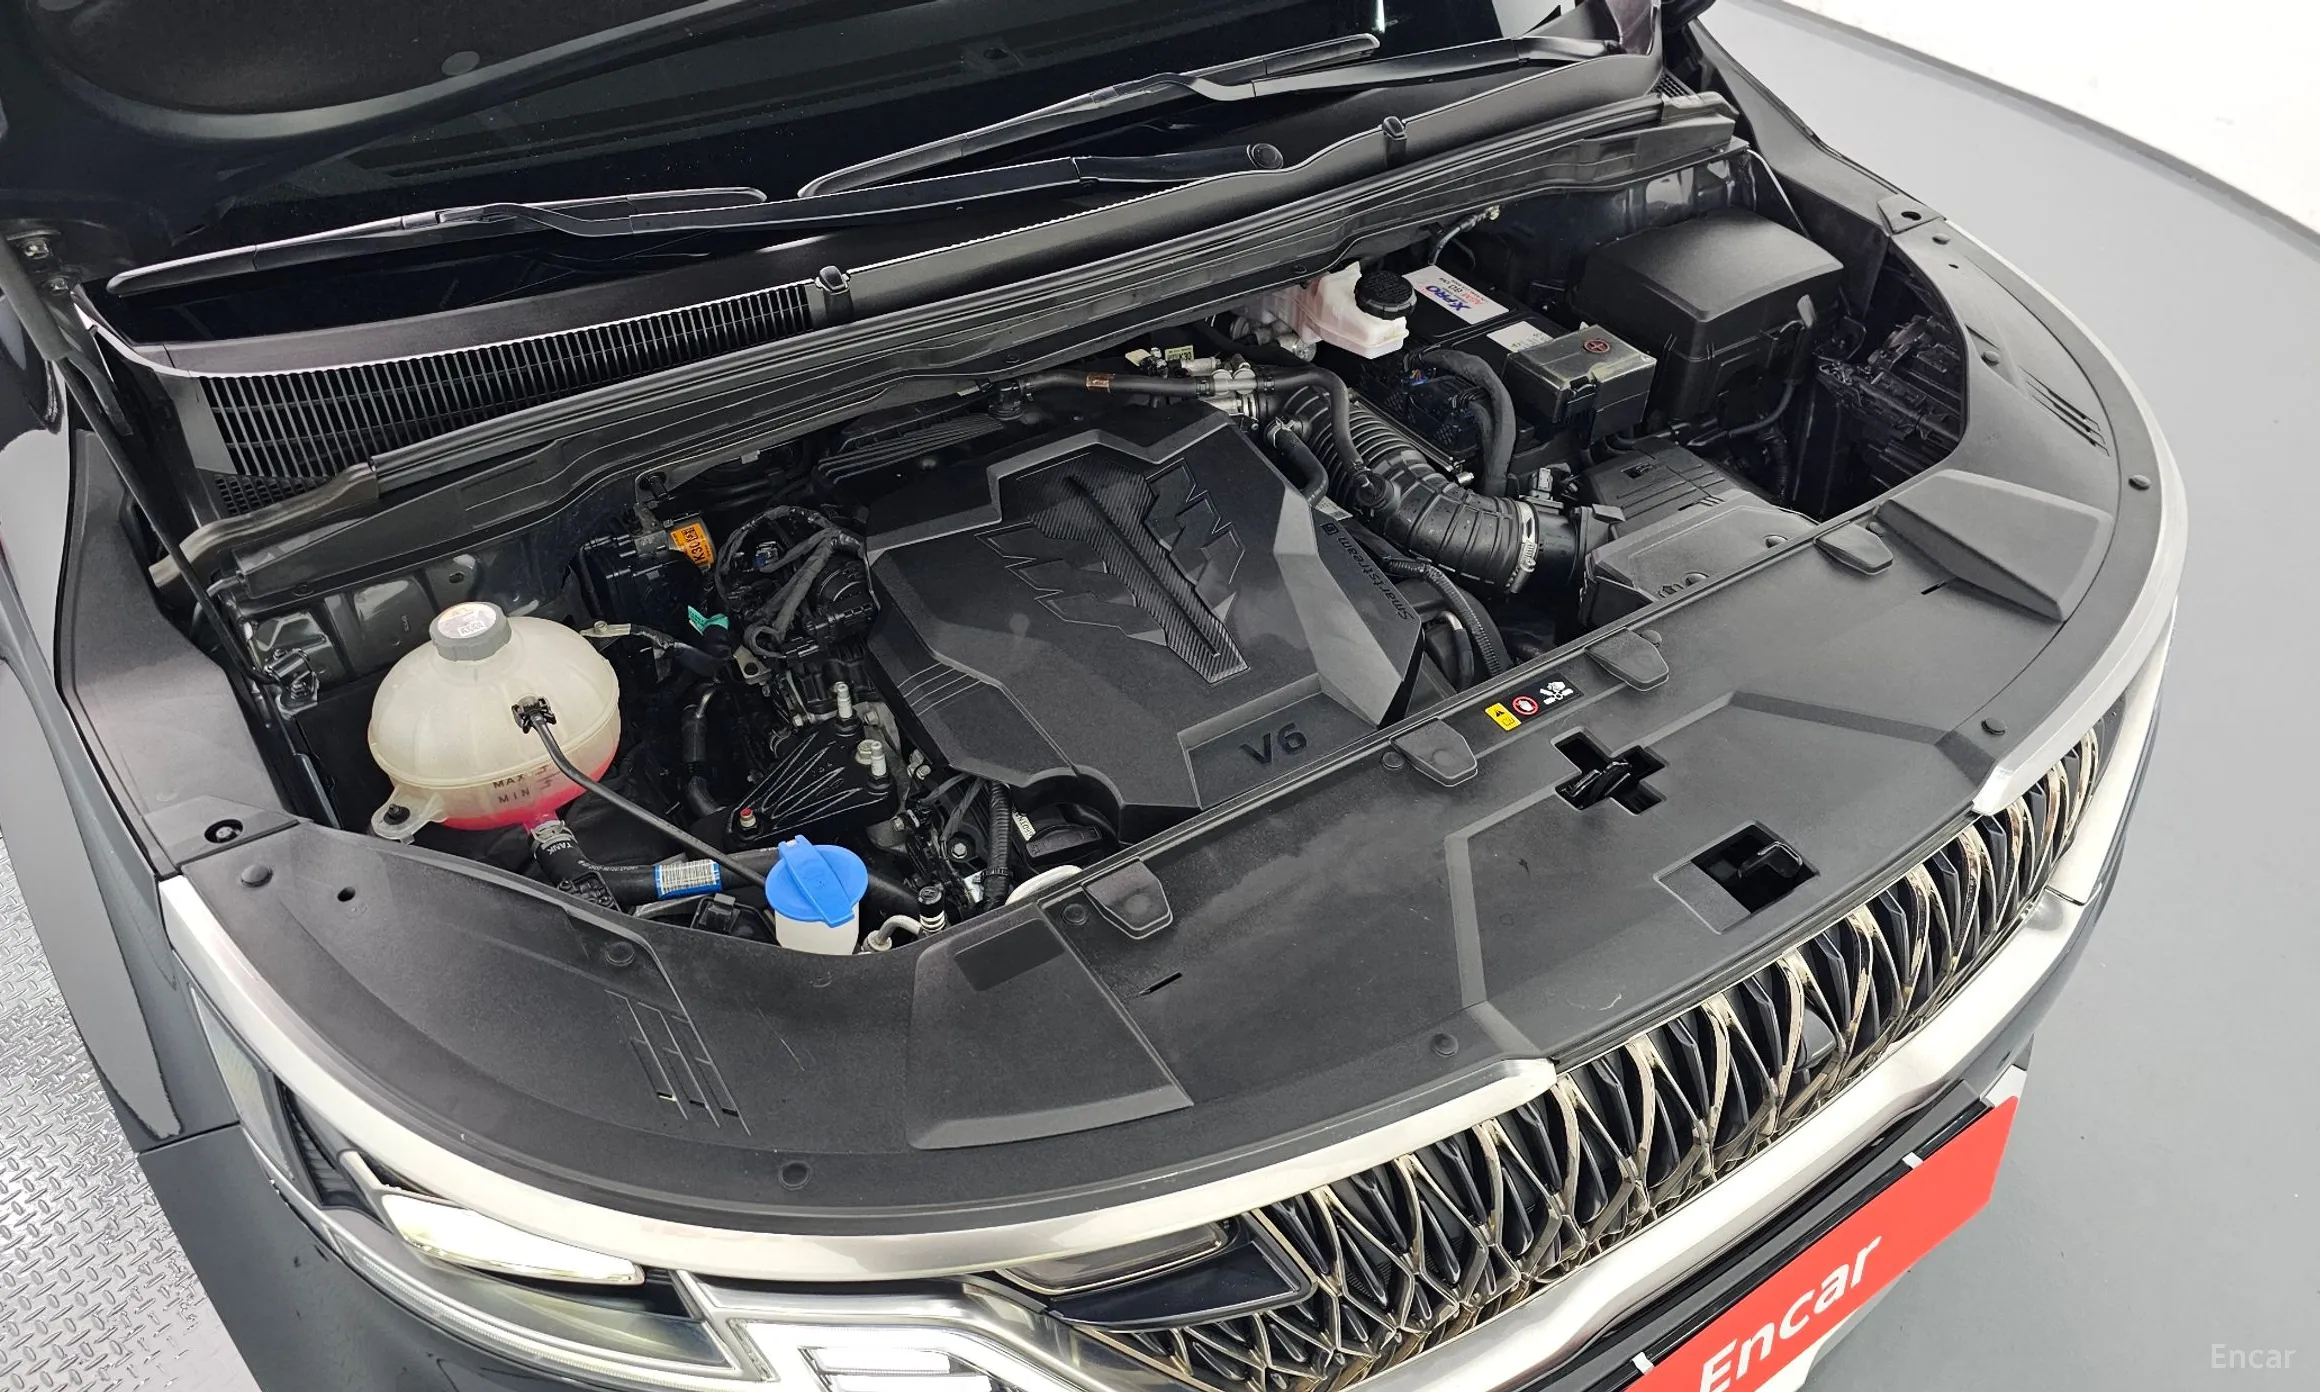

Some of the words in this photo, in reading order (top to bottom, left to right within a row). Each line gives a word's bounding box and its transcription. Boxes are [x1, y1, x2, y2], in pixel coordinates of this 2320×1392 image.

[1338, 536, 1415, 621] Smartstream
[1239, 722, 1307, 765] V6
[493, 773, 525, 789] MAX
[498, 788, 530, 804] MIN
[546, 841, 574, 856] TANK
[1700, 1235, 1882, 1392] Encar
